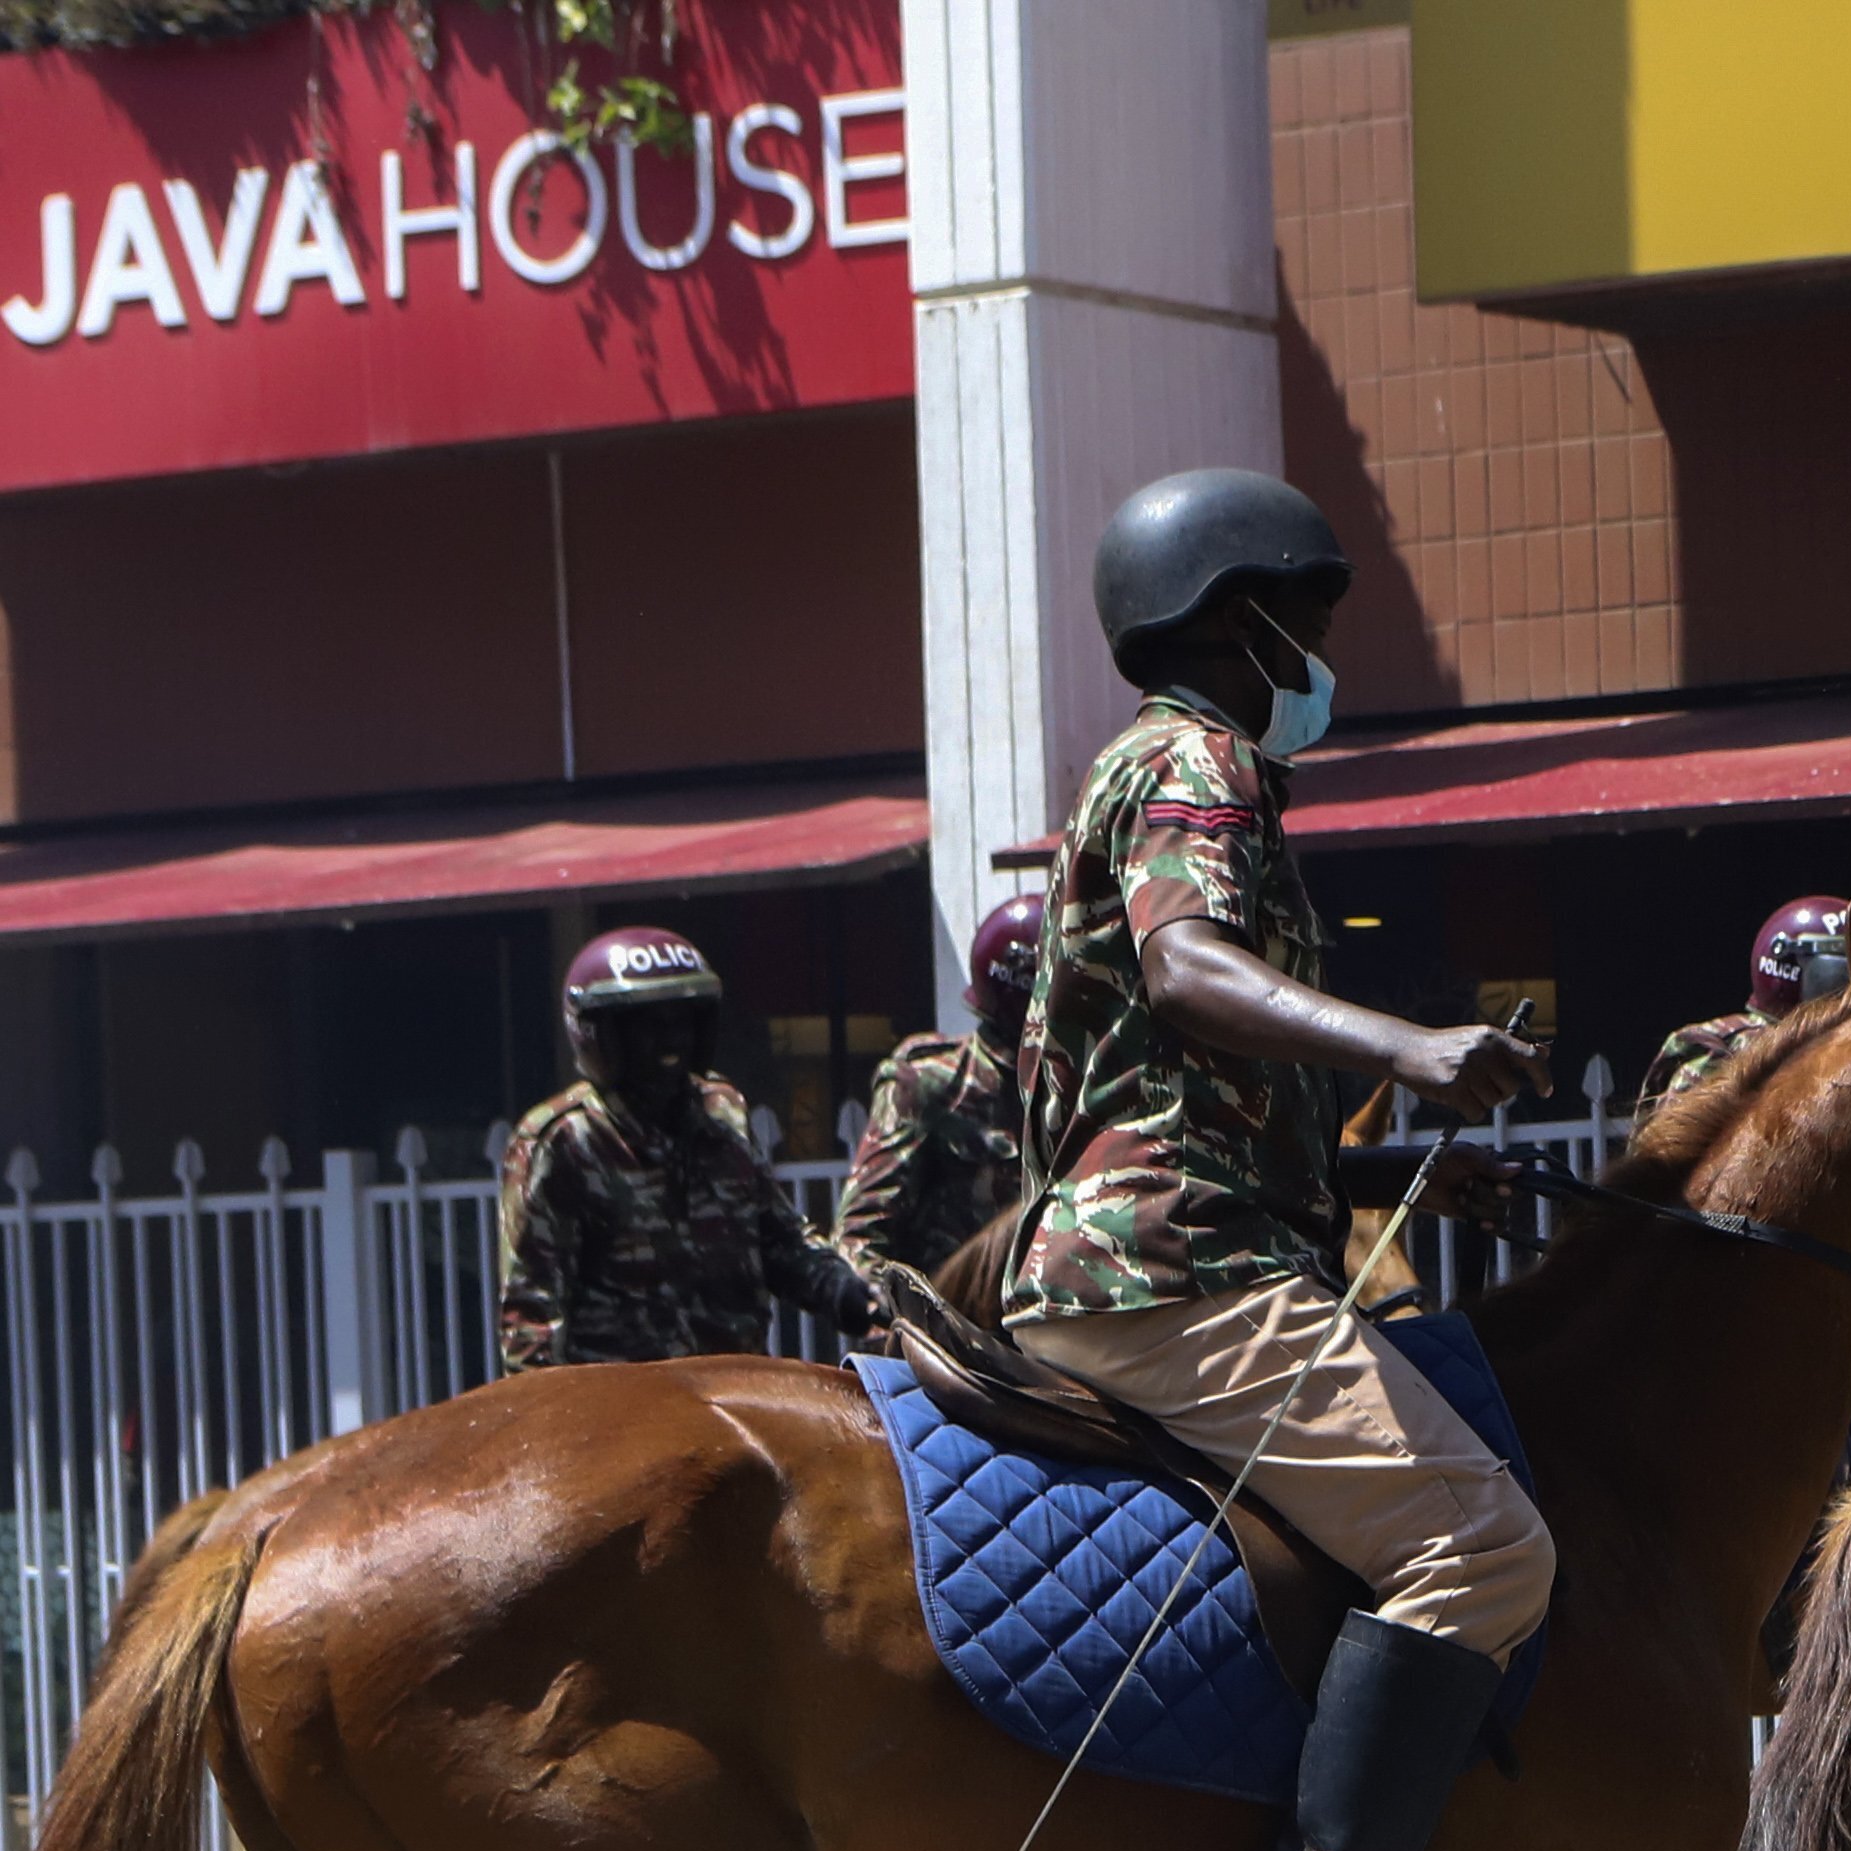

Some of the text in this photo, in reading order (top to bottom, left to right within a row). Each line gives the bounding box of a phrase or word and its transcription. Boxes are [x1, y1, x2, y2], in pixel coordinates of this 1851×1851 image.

[2, 88, 910, 346] JAVA HOUSE
[1759, 955, 1801, 982] POLICE
